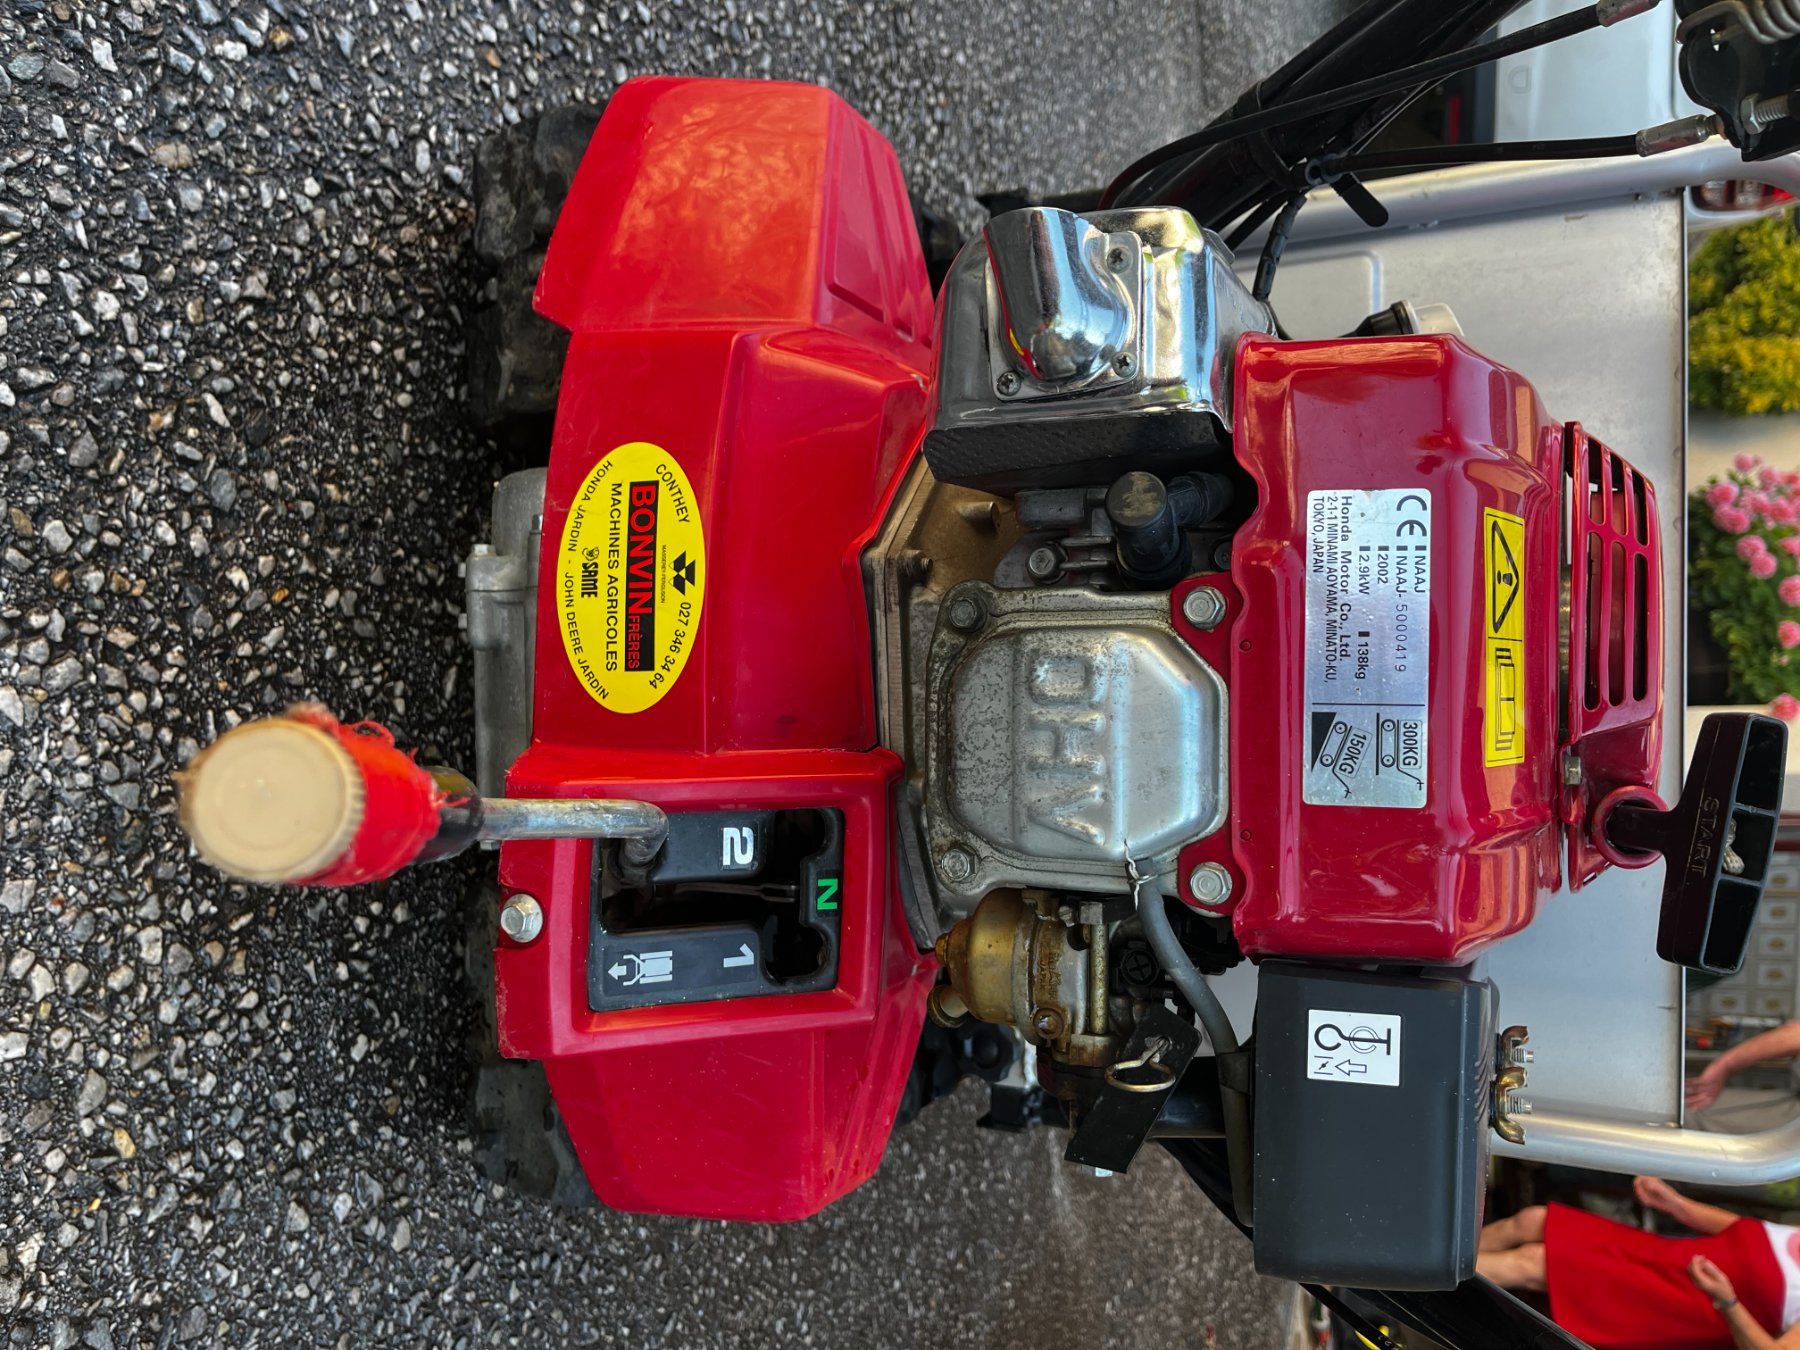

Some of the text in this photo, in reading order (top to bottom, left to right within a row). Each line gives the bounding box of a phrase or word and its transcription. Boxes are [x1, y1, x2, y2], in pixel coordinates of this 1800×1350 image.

[582, 460, 613, 501] HONDA
[655, 464, 690, 523] CONTHEY
[567, 505, 586, 551] JARDIN
[1312, 496, 1324, 573] TOKYO, JAPAN
[564, 572, 575, 607] JOHN
[581, 562, 598, 598] SAME
[606, 483, 622, 671] MACHINES AGRICOLES
[628, 485, 656, 669] BONVIN FRÈRES
[1324, 496, 1337, 683] 2-1-1 MINAMI AOYAMA, MINATO-KU,
[1338, 496, 1352, 661] Honda Motor Co., Ltd.
[1377, 554, 1388, 584] 2002
[1414, 556, 1426, 593] NAAJ
[565, 612, 583, 655] DEERE
[1355, 555, 1369, 679] 2.9kW 138kg
[1395, 604, 1407, 672] 5000419
[648, 602, 691, 689] 027 346 34 64
[577, 658, 609, 700] JARDIN
[1027, 647, 1106, 846] OHV
[1338, 731, 1368, 775] 150KG
[1402, 722, 1419, 766] 300KG
[723, 827, 754, 865] 2
[1691, 797, 1720, 878] START
[817, 878, 838, 910] N
[723, 944, 754, 968] 1
